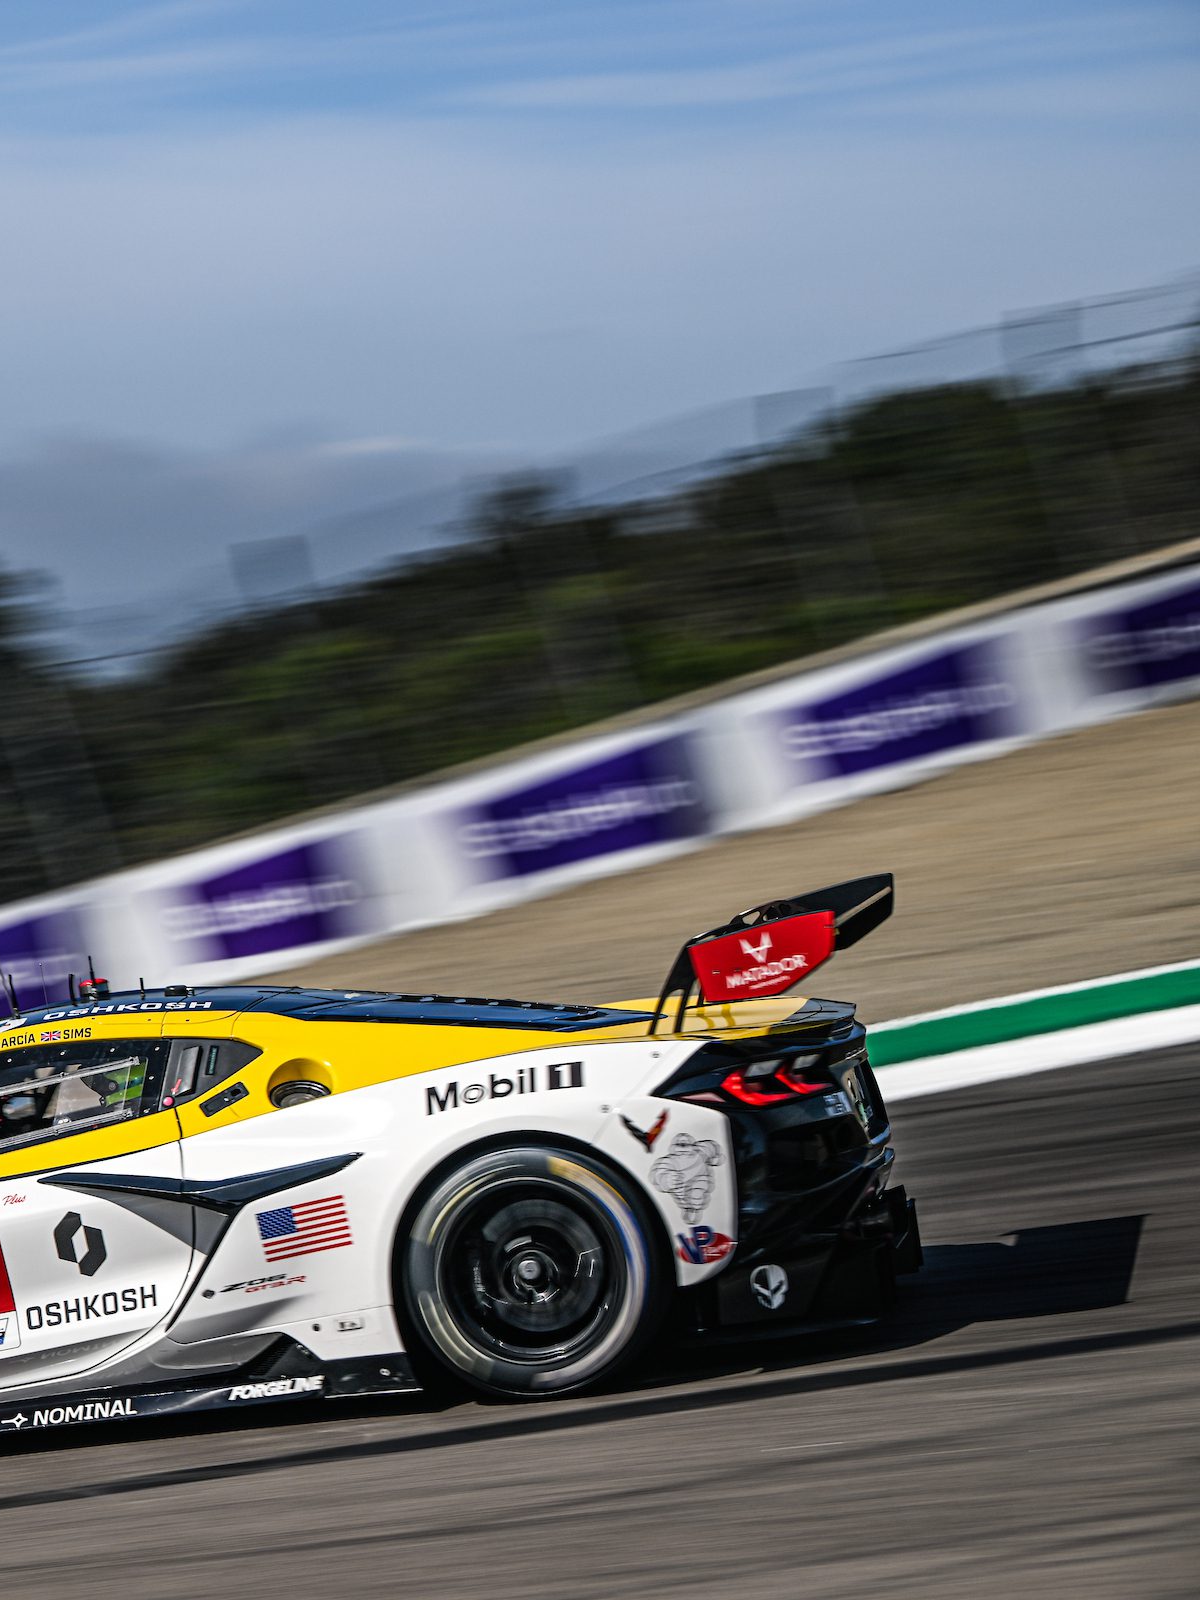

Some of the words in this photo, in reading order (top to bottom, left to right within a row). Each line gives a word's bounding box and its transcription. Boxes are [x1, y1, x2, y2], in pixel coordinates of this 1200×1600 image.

[725, 954, 809, 989] MATADOR
[43, 1001, 213, 1021] OSHKOSH
[62, 1027, 92, 1040] SIMS
[425, 1067, 537, 1116] Mobil
[26, 1284, 158, 1330] OSHKOSH
[228, 1375, 326, 1401] FORGELINE
[32, 1398, 138, 1427] NOMINAL
